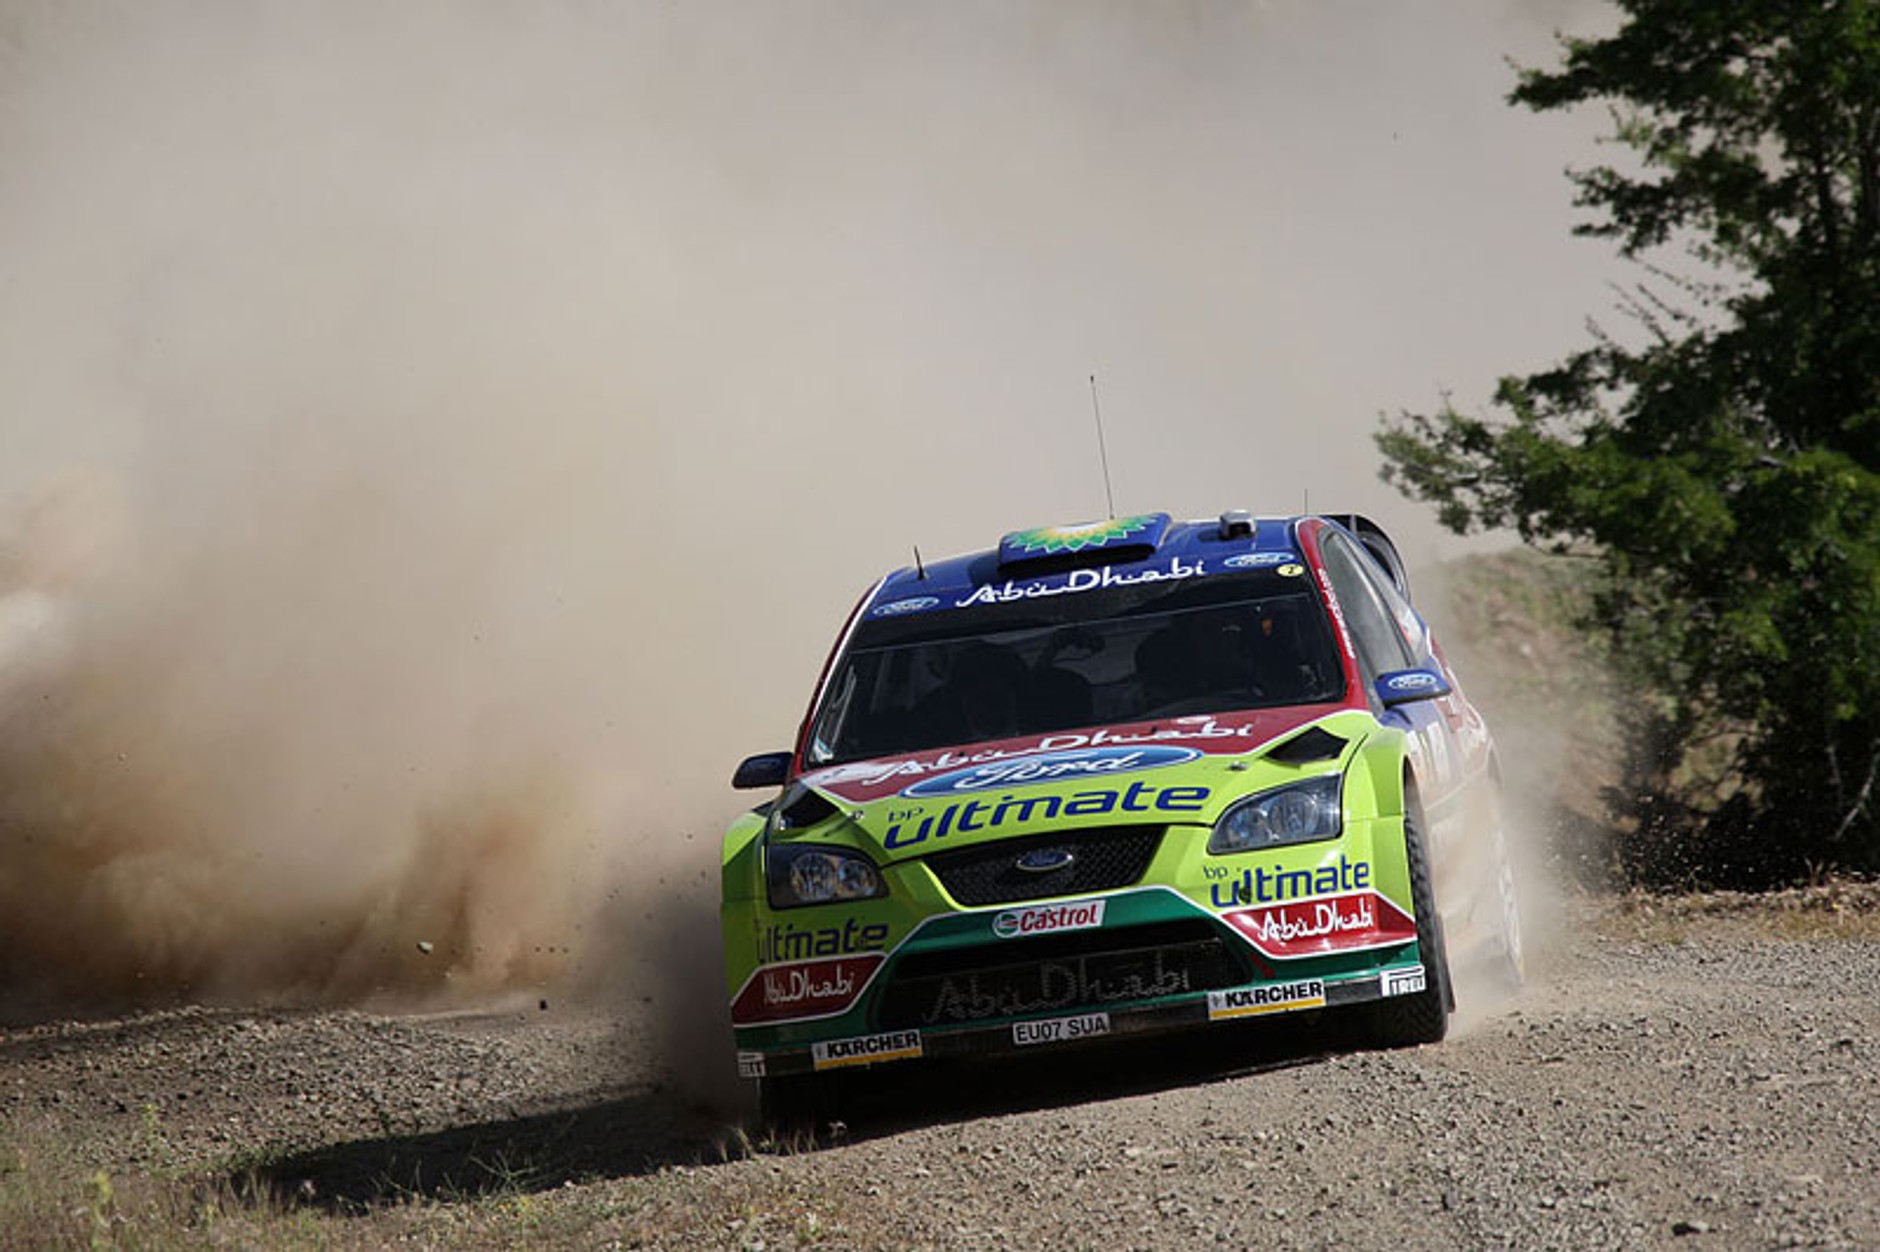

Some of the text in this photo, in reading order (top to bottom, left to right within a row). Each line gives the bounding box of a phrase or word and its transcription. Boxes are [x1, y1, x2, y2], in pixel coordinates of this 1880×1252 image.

[954, 751, 1146, 789] Ford
[884, 781, 1211, 849] ultimate
[1203, 865, 1228, 880] bp
[1211, 854, 1370, 908] ultimate
[1020, 904, 1098, 932] Castrol
[1016, 1016, 1108, 1043] EU07 SUA
